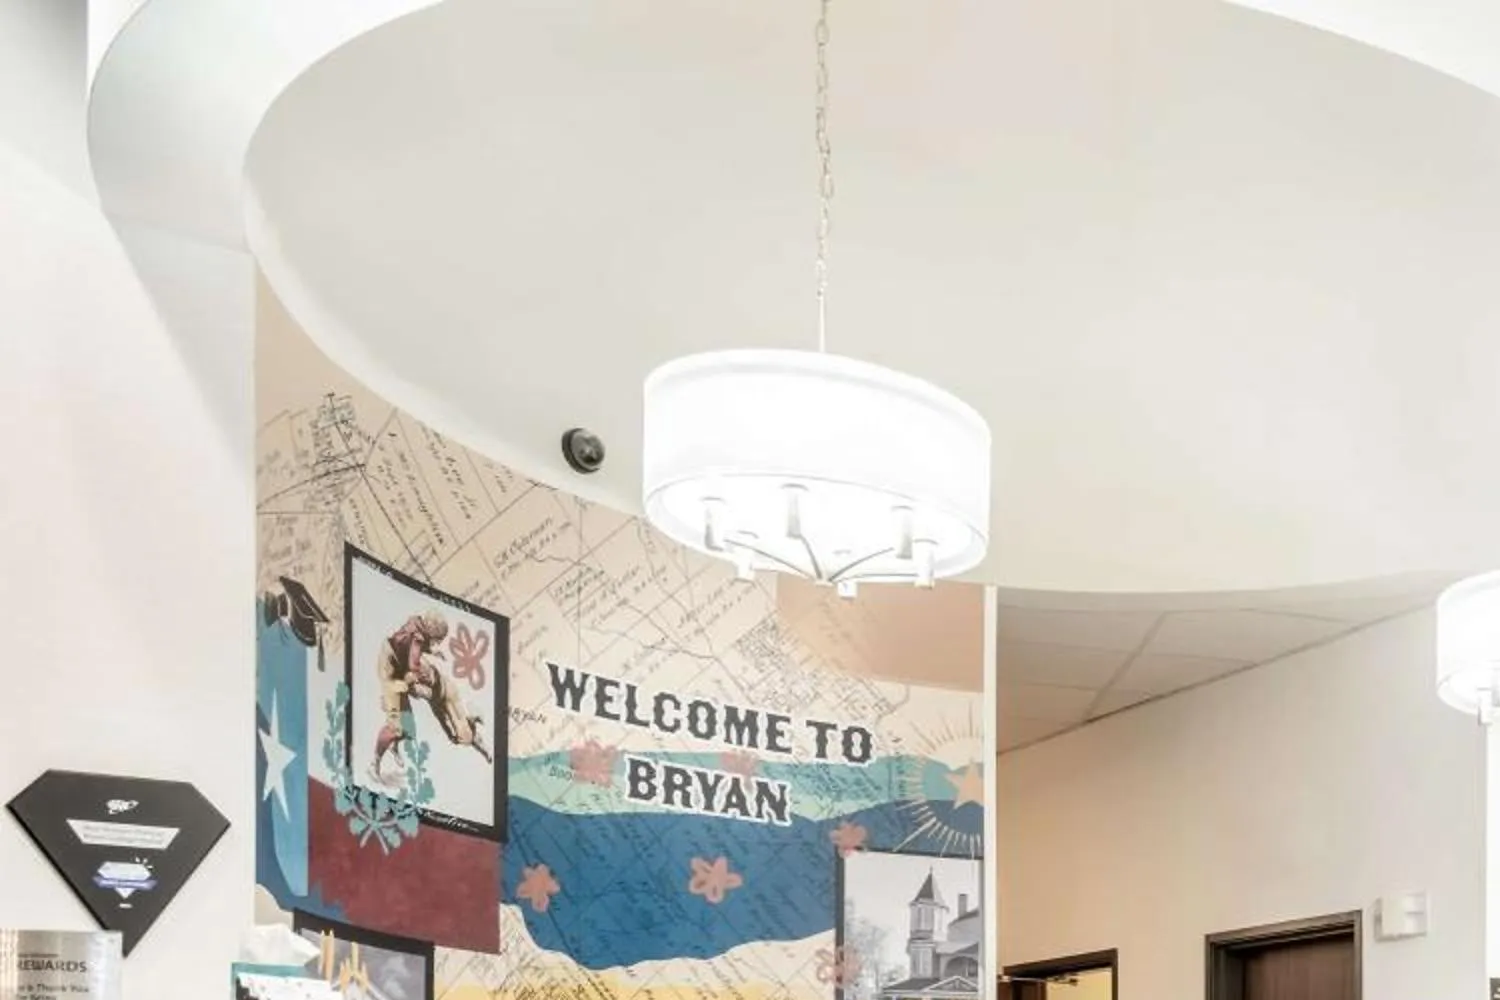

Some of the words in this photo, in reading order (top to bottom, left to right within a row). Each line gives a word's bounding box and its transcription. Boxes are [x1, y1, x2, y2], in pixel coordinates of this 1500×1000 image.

[547, 662, 793, 754] WELCOME
[806, 719, 873, 764] TO
[627, 756, 789, 823] BRYAN
